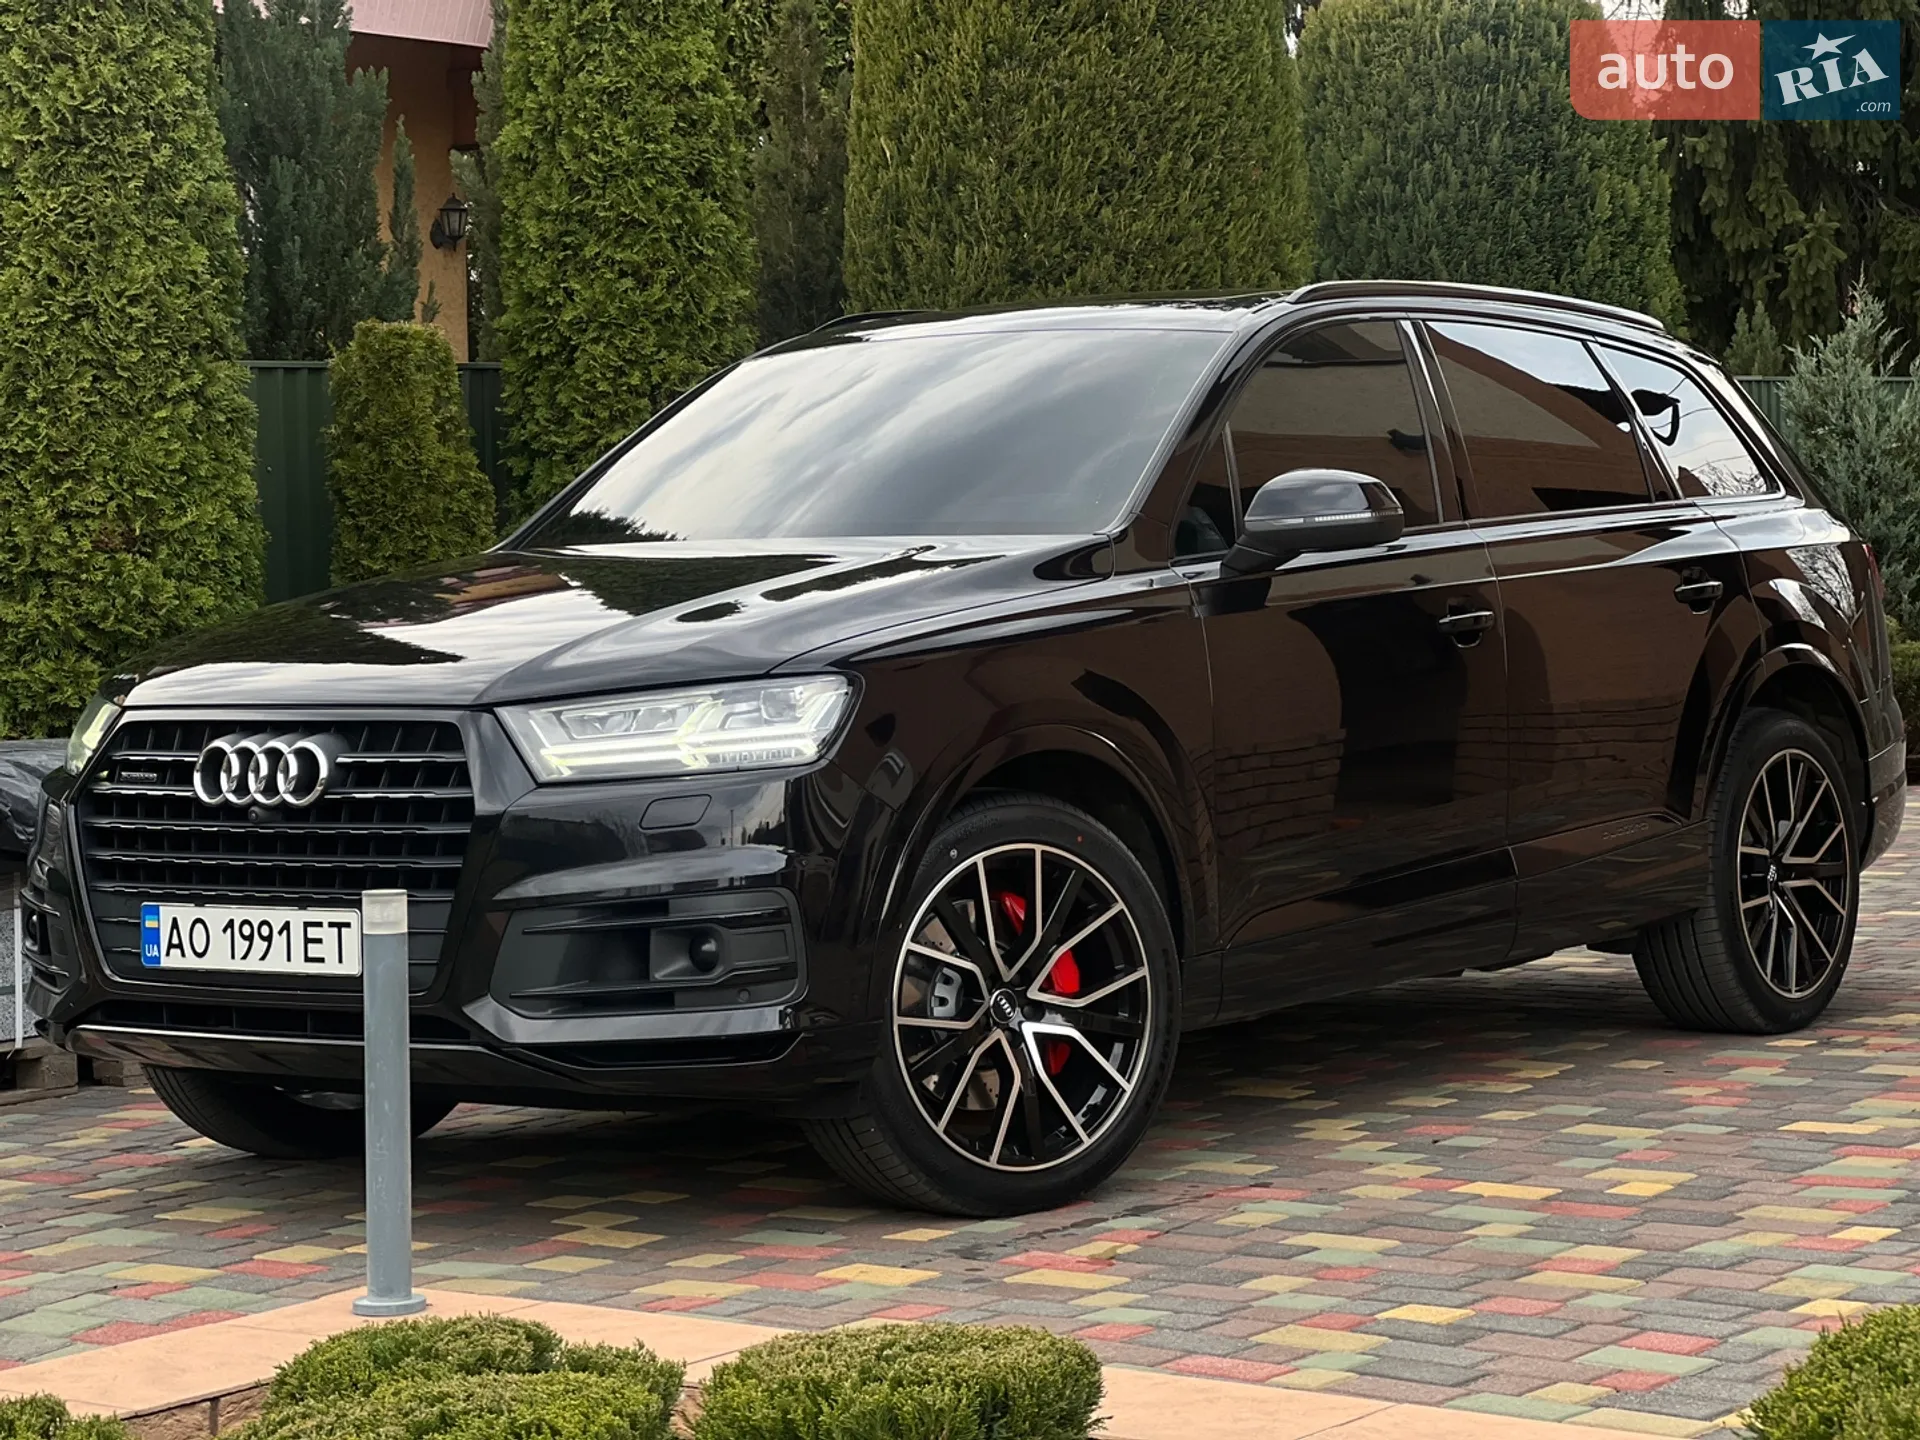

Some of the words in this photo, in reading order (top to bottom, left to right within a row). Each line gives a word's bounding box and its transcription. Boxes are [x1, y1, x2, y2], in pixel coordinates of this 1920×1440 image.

[145, 944, 160, 958] UA
[165, 916, 211, 959] AO
[221, 918, 292, 963] 1991
[302, 921, 352, 964] ET
